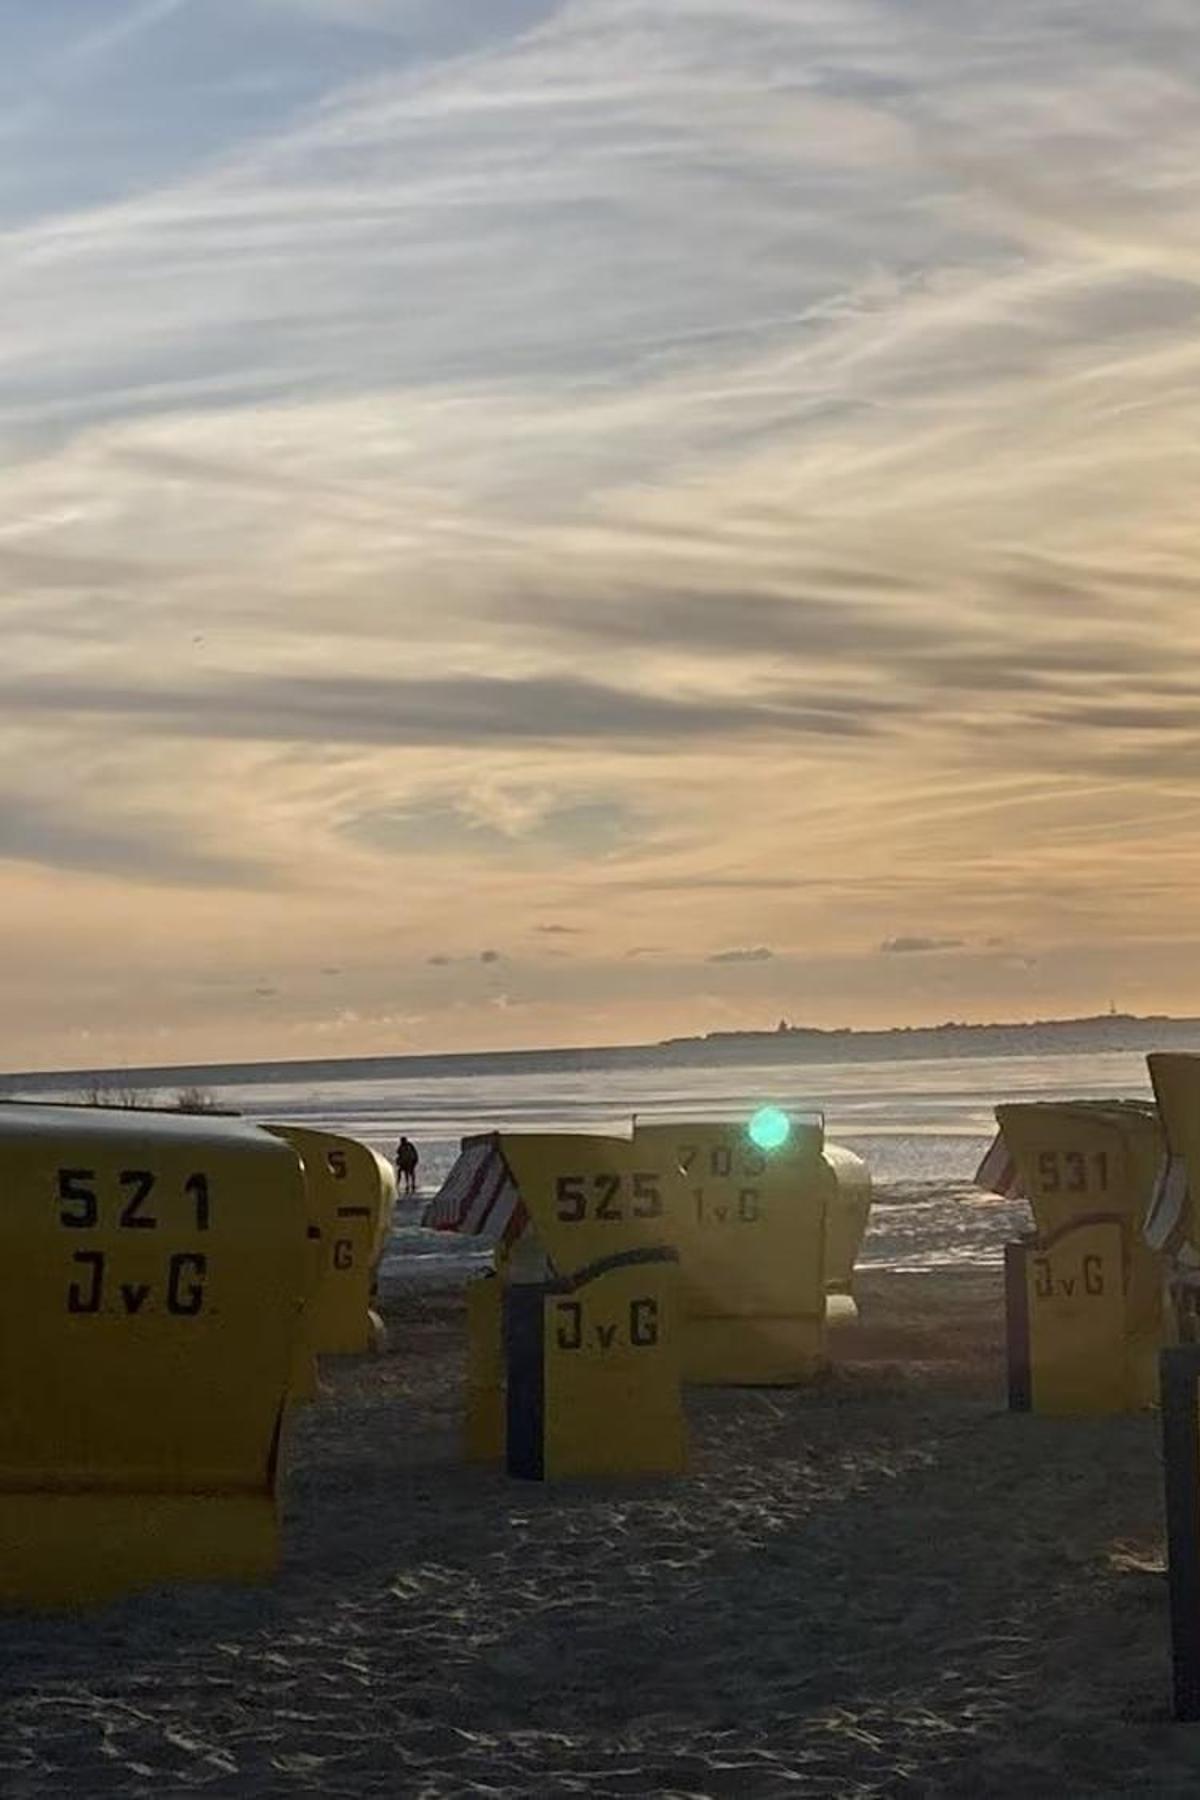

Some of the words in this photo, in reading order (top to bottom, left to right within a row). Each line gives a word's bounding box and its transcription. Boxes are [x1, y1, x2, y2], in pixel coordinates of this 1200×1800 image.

[554, 1172, 663, 1223] 525
[1037, 1151, 1108, 1193] 531
[57, 1168, 210, 1231] 521
